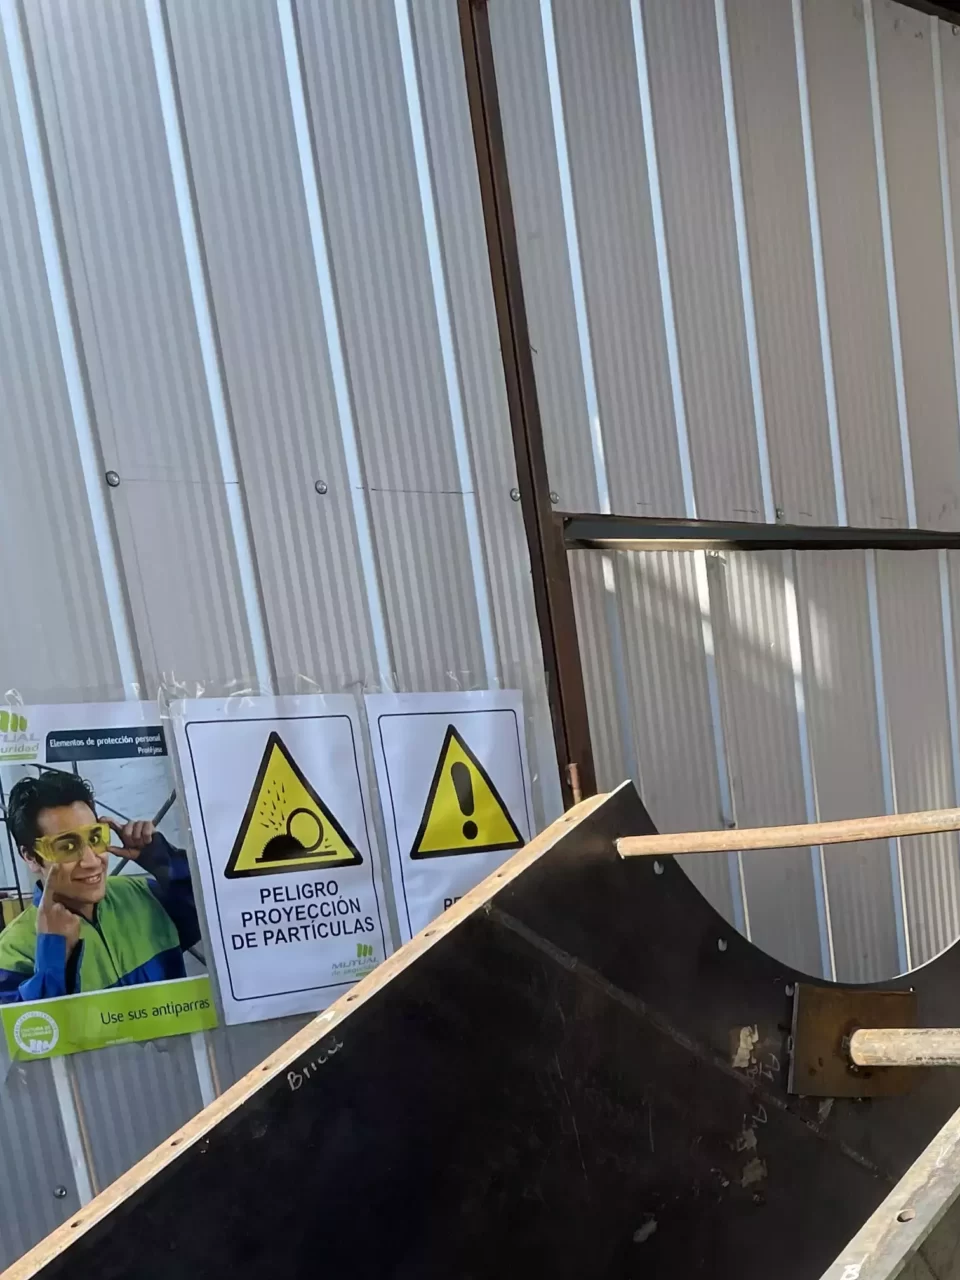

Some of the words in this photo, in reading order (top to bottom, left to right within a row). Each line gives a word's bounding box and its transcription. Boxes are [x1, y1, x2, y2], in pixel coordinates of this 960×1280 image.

[50, 738, 85, 748] Elementos
[86, 737, 95, 746] de
[96, 735, 134, 747] protección
[135, 733, 161, 744] personal
[259, 880, 339, 904] PELIGRO
[241, 895, 361, 928] PROYECCIÓN
[231, 932, 258, 950] DE
[263, 916, 375, 946] PARTÍCULAS
[331, 957, 379, 970] MUTUAL
[101, 1012, 124, 1025] Use
[128, 1008, 148, 1020] sus
[152, 998, 210, 1018] antiparras
